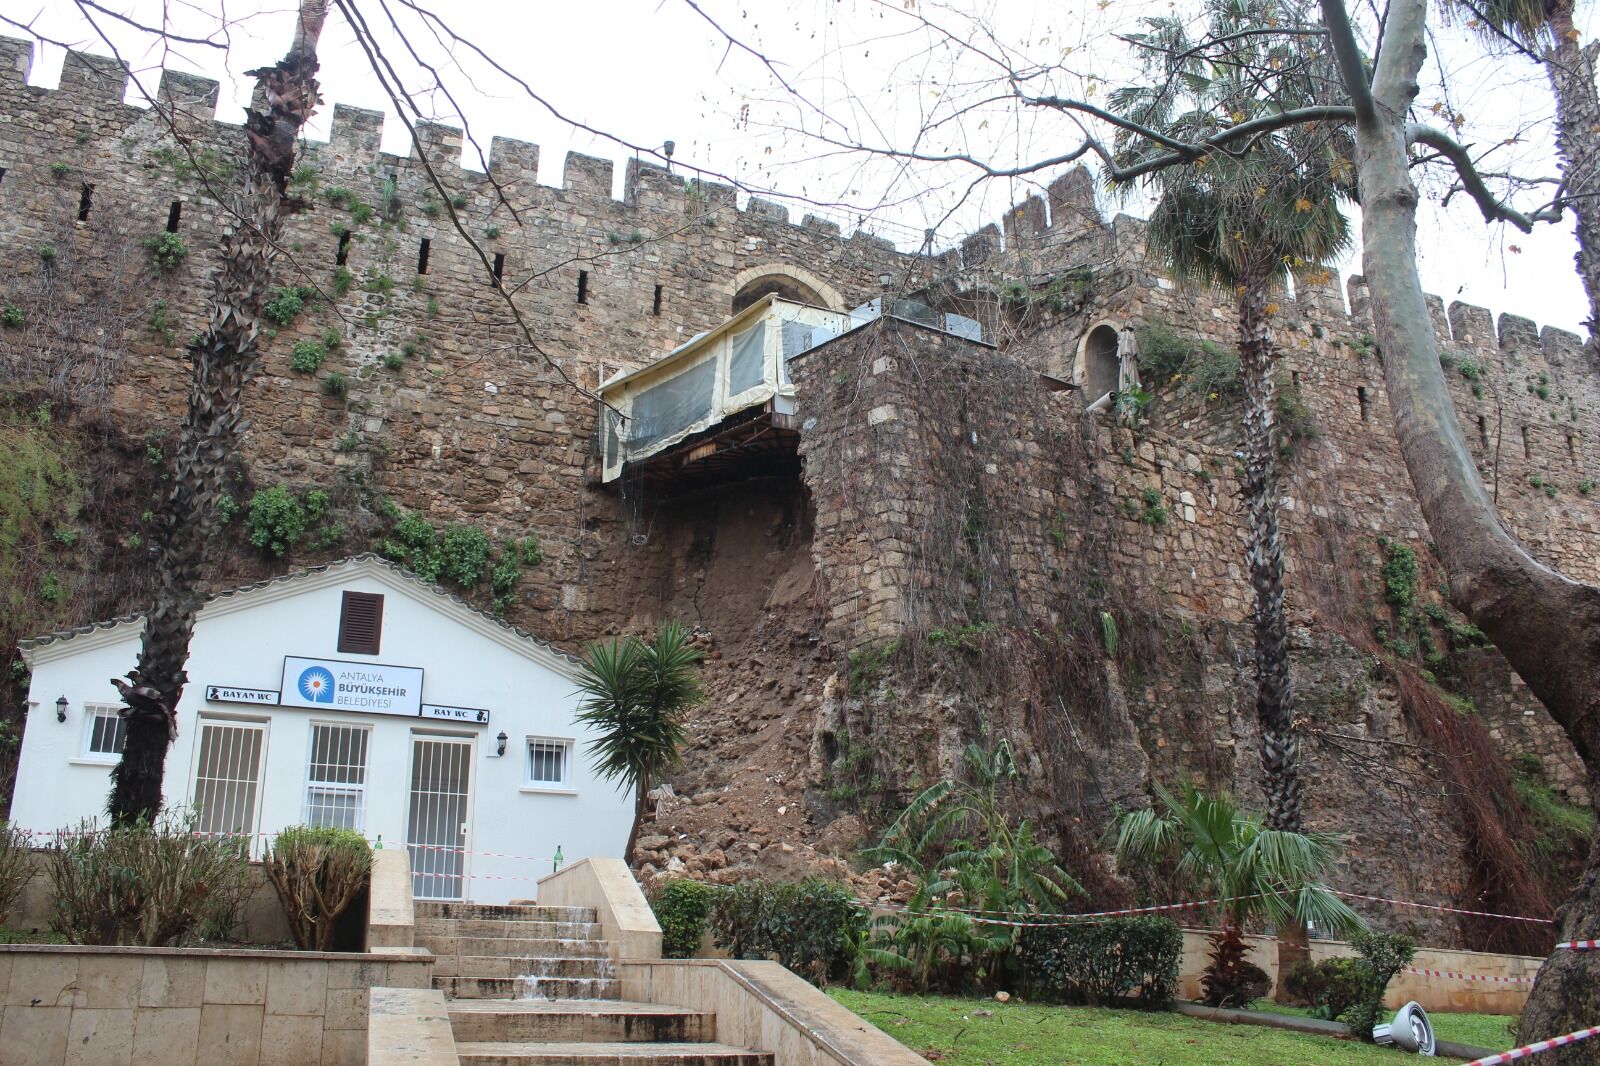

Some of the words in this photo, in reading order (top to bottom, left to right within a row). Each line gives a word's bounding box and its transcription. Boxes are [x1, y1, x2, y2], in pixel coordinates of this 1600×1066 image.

[339, 671, 384, 683] ANTALYA
[223, 690, 255, 699] BAYAN
[257, 692, 272, 701] WC
[338, 682, 406, 697] BÜYÜKŞEHİR
[337, 695, 392, 708] BELEDİYESİ
[434, 708, 452, 717] BAY
[454, 710, 468, 718] WC
